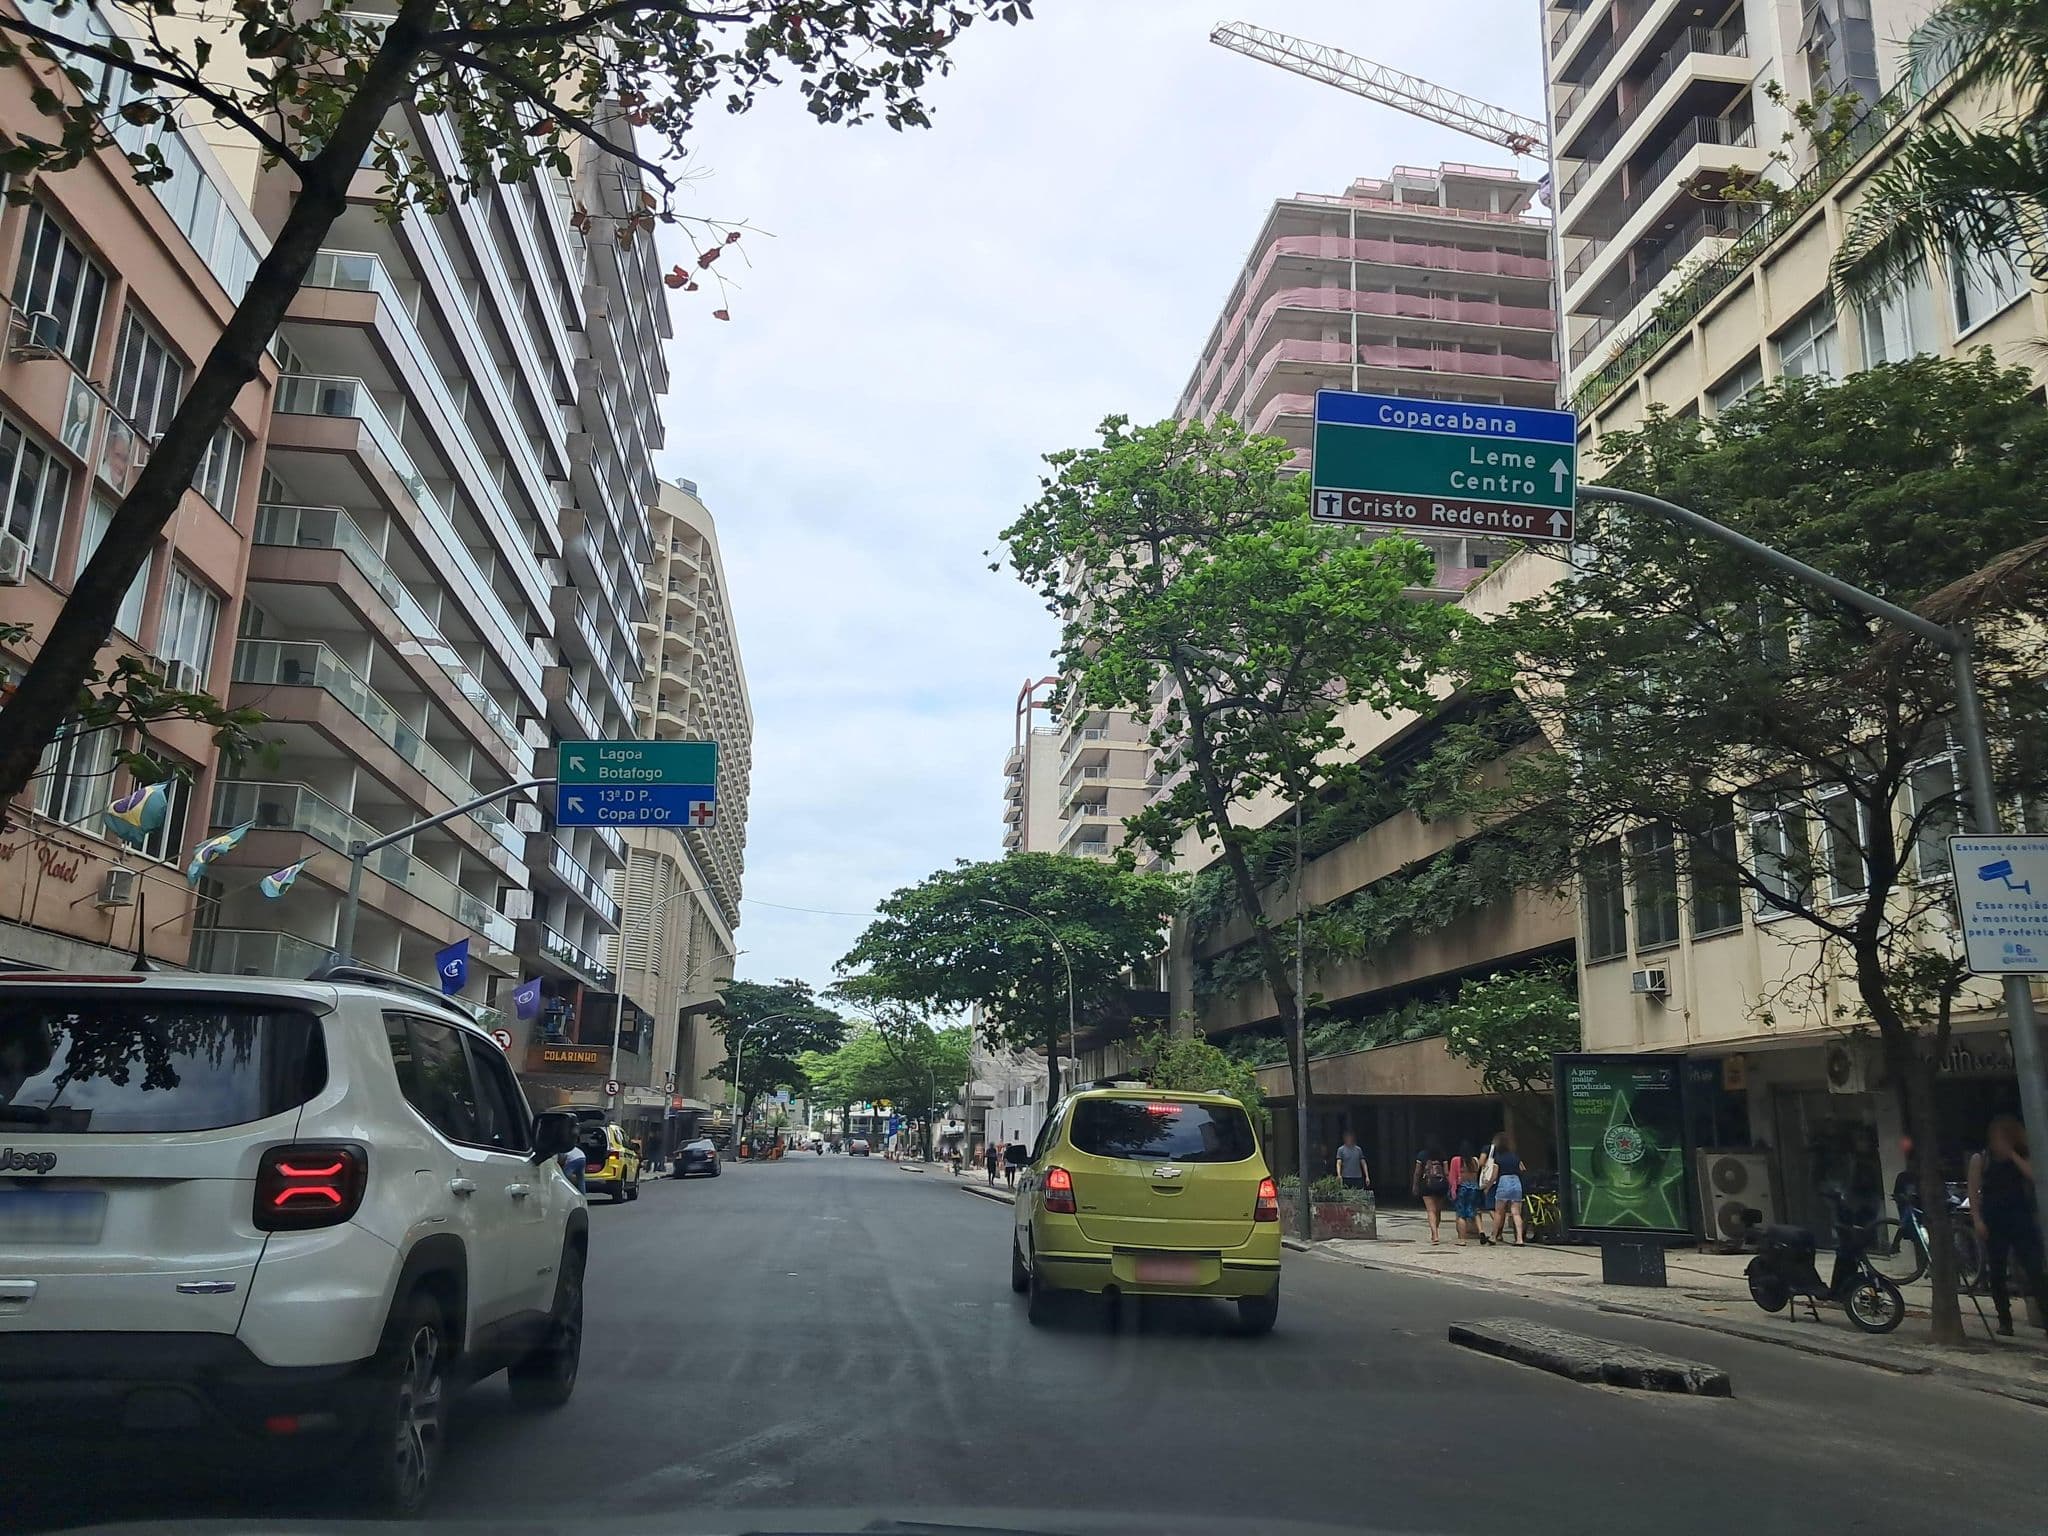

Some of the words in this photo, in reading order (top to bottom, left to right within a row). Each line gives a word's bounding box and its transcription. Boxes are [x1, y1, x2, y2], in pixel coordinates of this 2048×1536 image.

[1378, 404, 1517, 433] Copacabana
[1470, 446, 1536, 469] Leme
[1450, 470, 1536, 495] Centro
[1347, 496, 1417, 519] Cristo
[1431, 503, 1535, 530] Redentor
[600, 748, 643, 763] Lagoa
[599, 766, 663, 781] Botafogo
[598, 808, 636, 822] Copa
[640, 808, 671, 820] D'Or
[38, 845, 79, 884] Hotel
[1976, 901, 2004, 910] Essa
[1968, 928, 1994, 938] pela
[544, 1050, 597, 1063] COLARINHO
[1579, 1069, 1598, 1077] puro
[0, 1143, 58, 1175] Jeep
